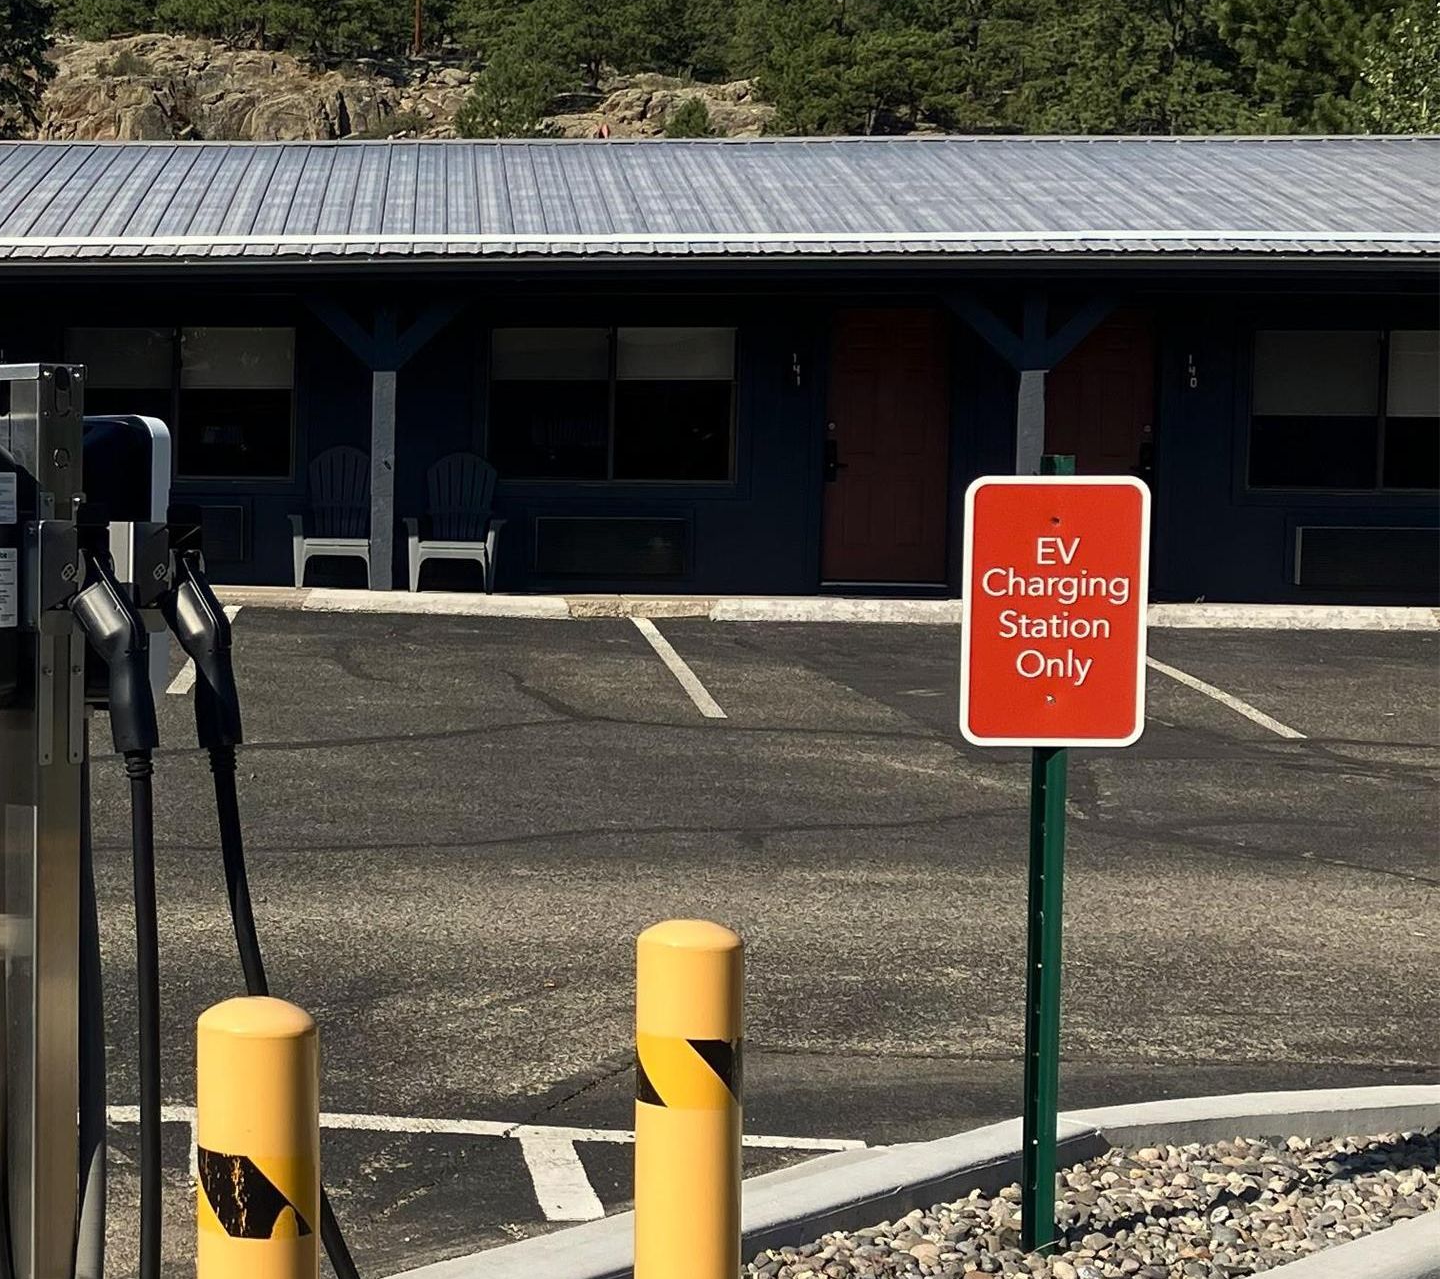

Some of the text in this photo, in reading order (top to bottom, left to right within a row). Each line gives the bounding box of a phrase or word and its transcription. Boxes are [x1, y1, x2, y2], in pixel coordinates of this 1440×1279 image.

[1036, 536, 1081, 565] EV
[981, 567, 1130, 605] Charging
[998, 609, 1110, 639] Station
[1015, 649, 1093, 686] Only
